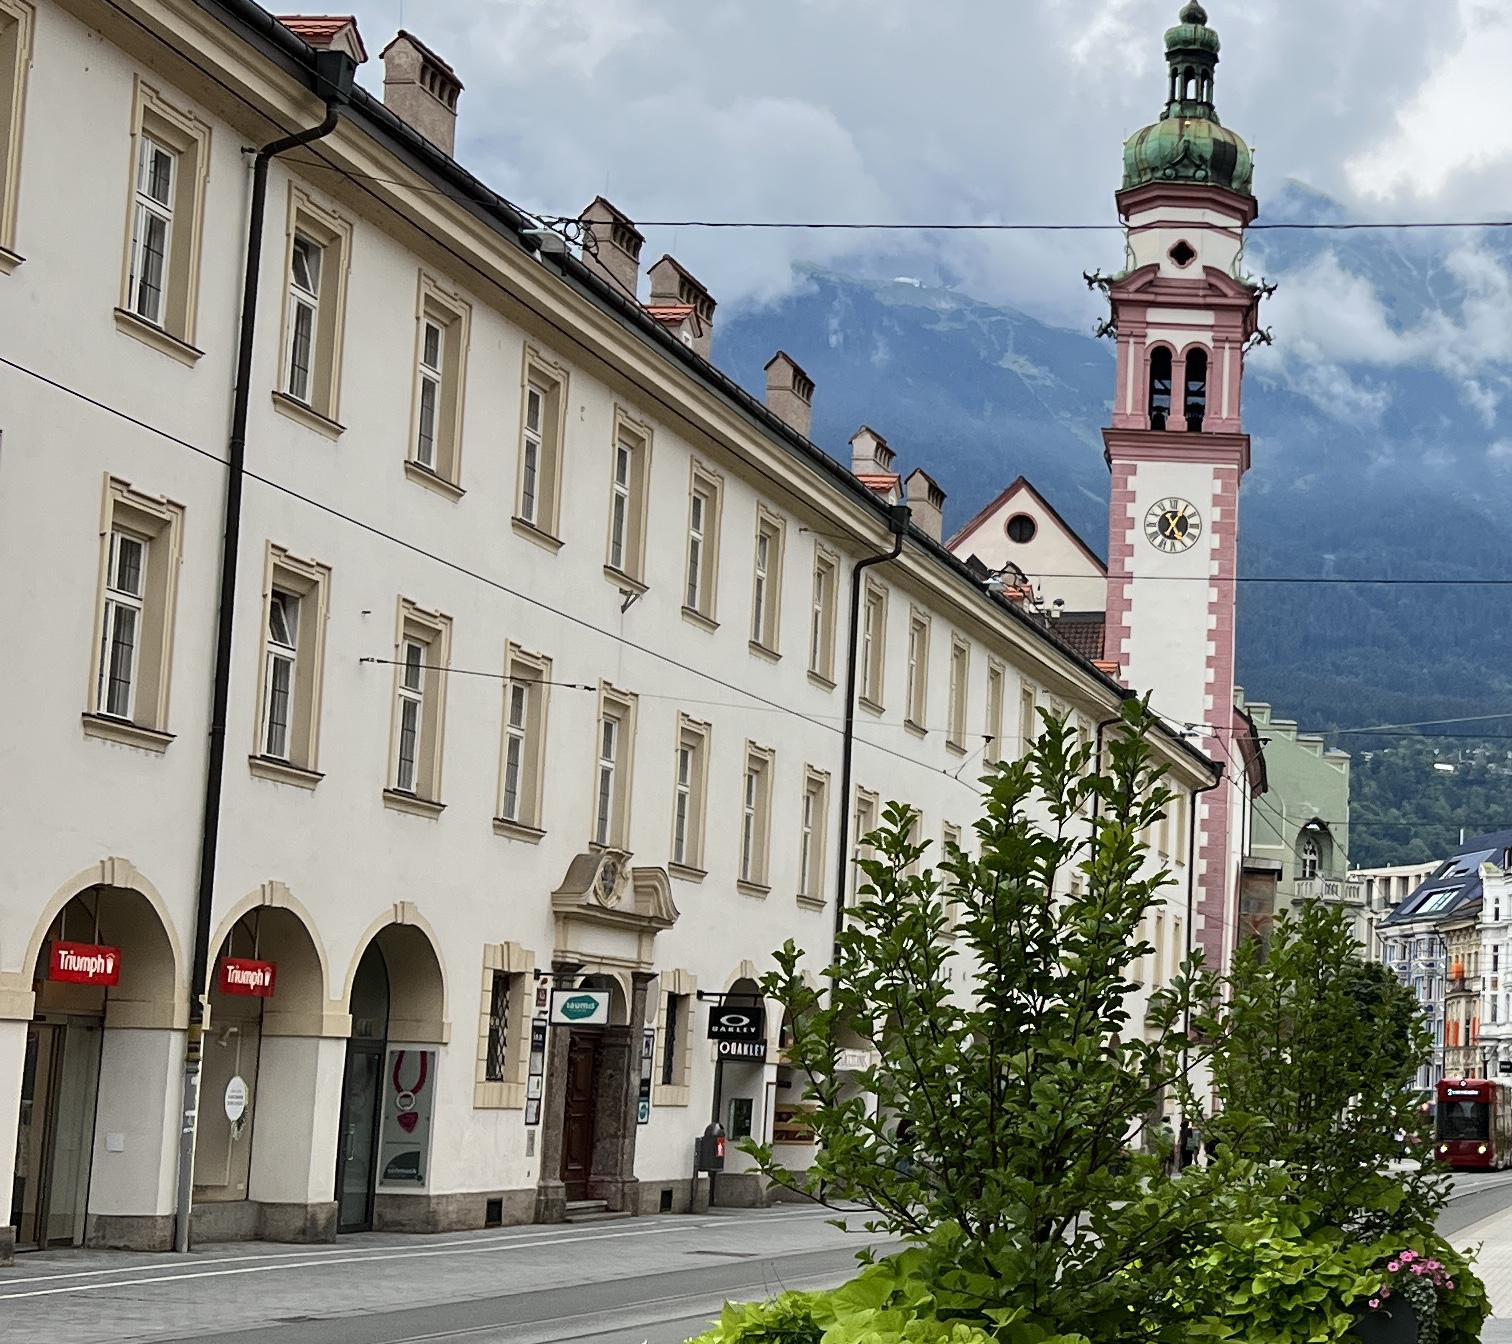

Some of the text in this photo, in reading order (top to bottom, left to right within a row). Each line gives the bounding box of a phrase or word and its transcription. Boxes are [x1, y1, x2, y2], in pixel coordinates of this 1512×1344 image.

[58, 950, 104, 978] Triumph
[227, 965, 263, 990] Triumph
[711, 1025, 756, 1033] OAKLEY
